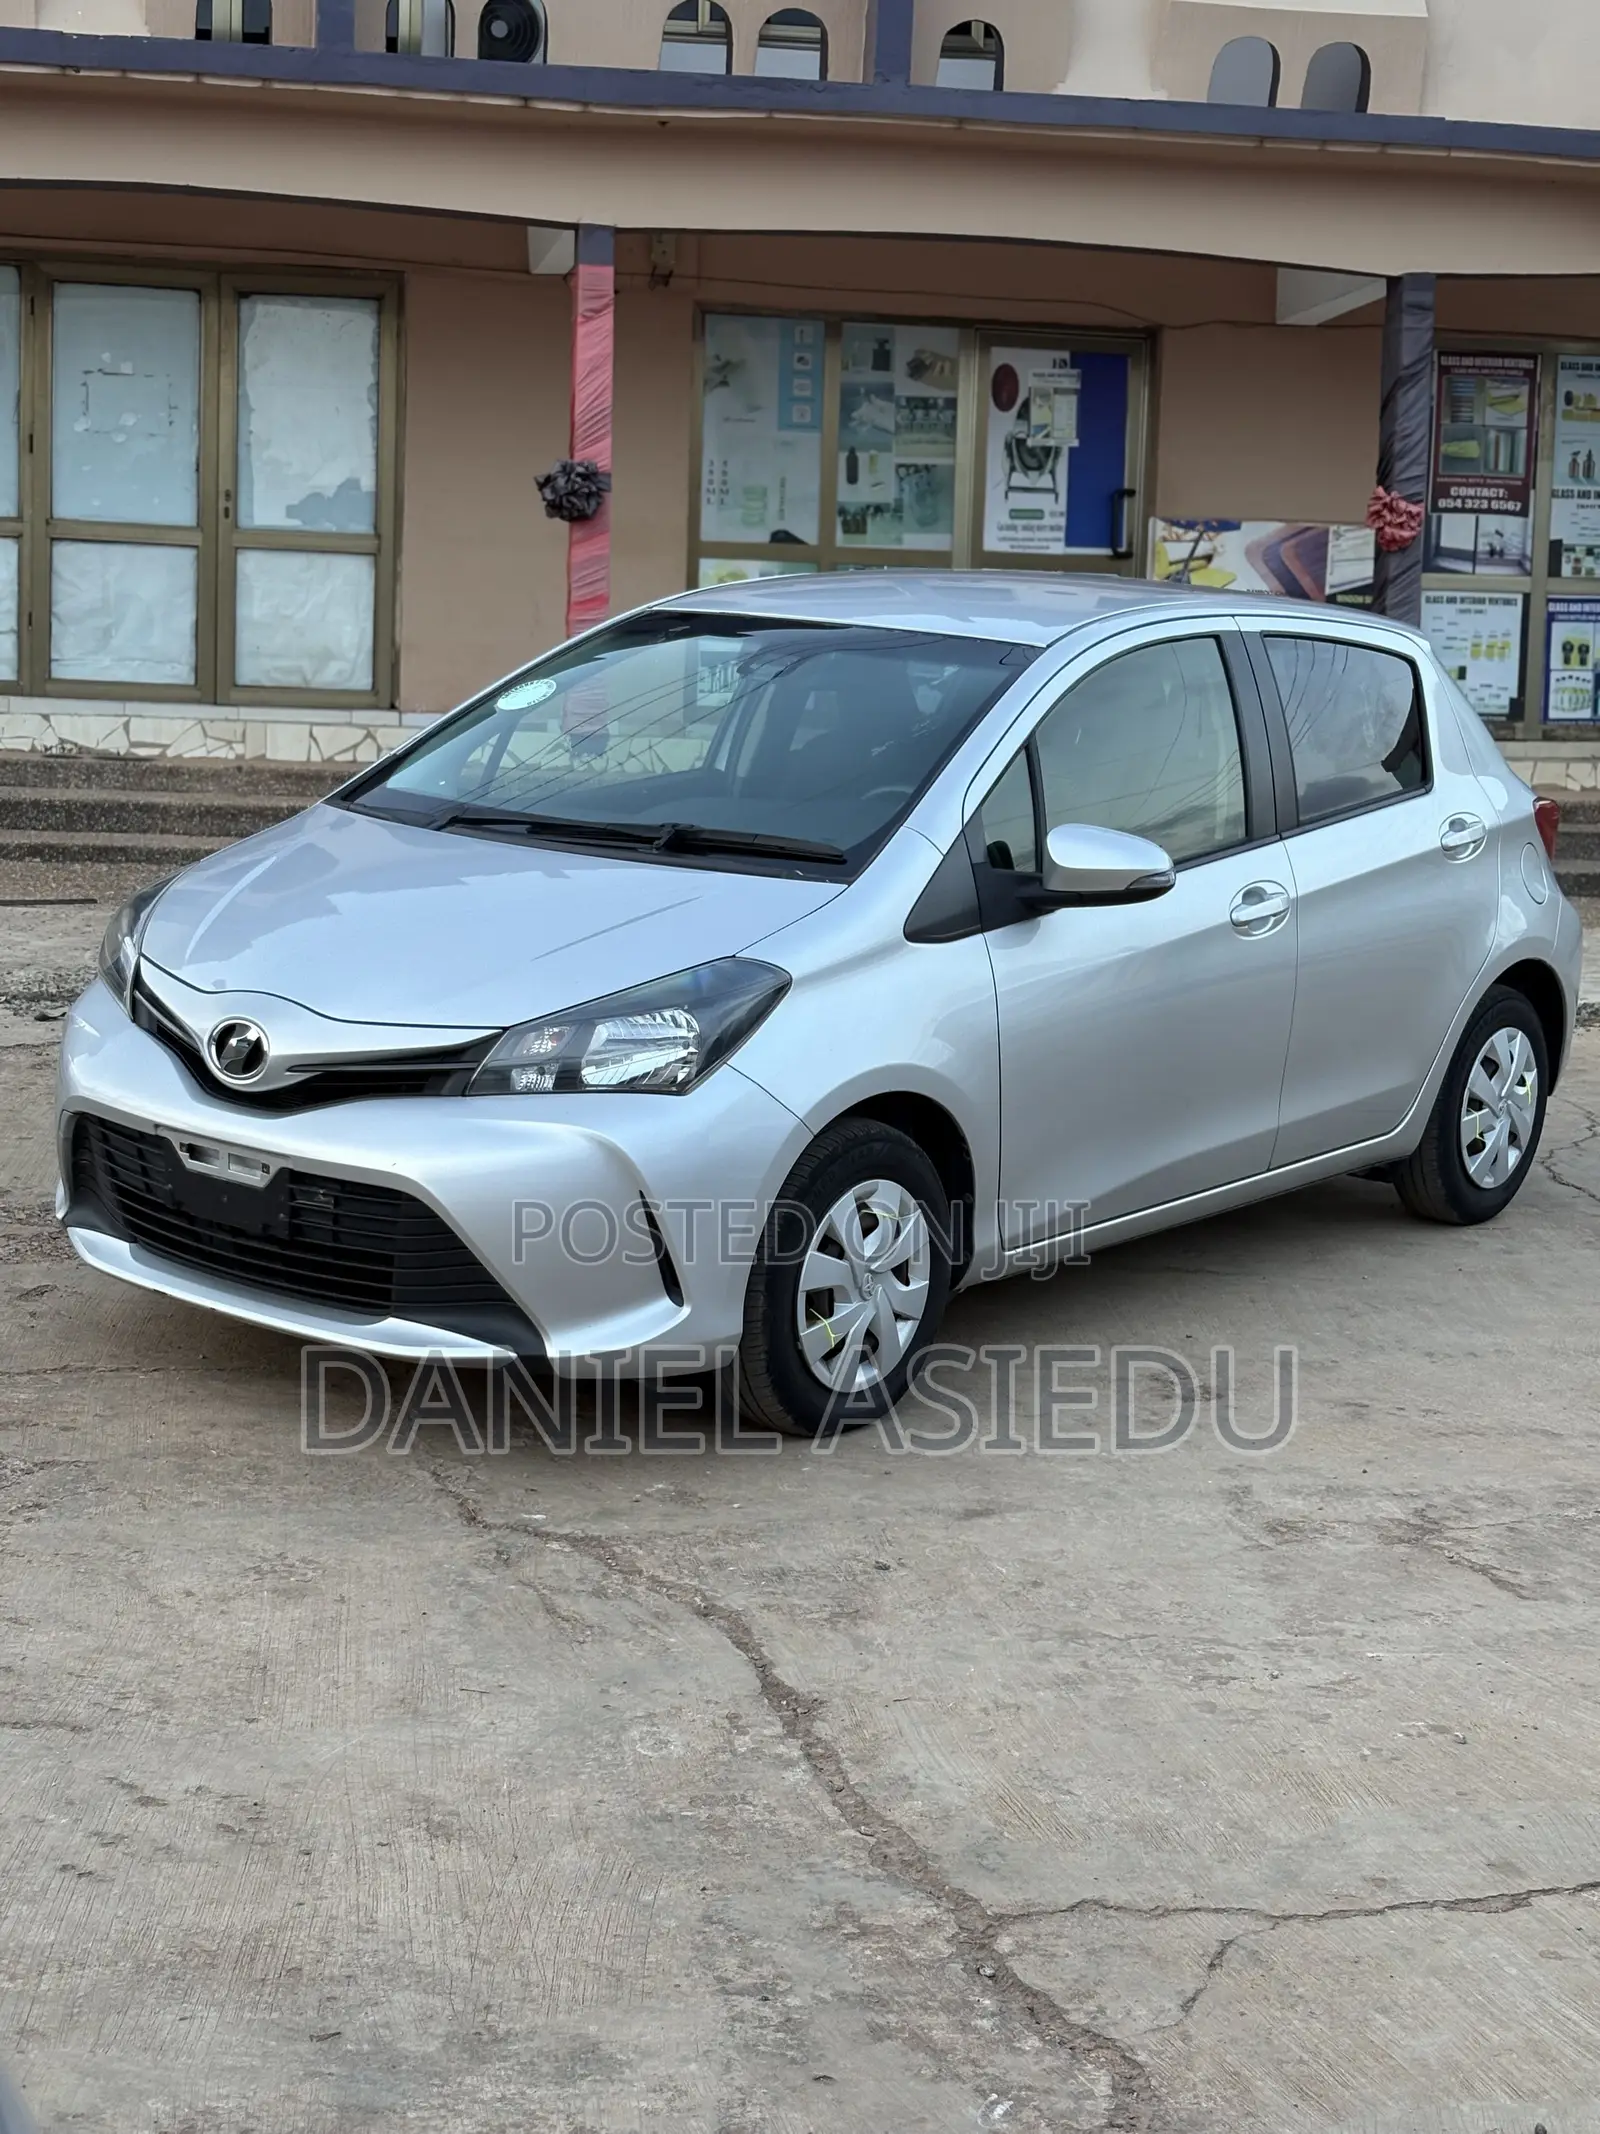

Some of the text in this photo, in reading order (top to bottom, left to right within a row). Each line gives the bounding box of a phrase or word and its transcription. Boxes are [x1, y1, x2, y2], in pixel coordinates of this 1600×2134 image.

[1450, 486, 1509, 499] CONTACT:
[1552, 488, 1575, 500] GLASS
[1577, 489, 1592, 501] AND
[1438, 498, 1463, 509] 054
[1464, 498, 1489, 510] 323
